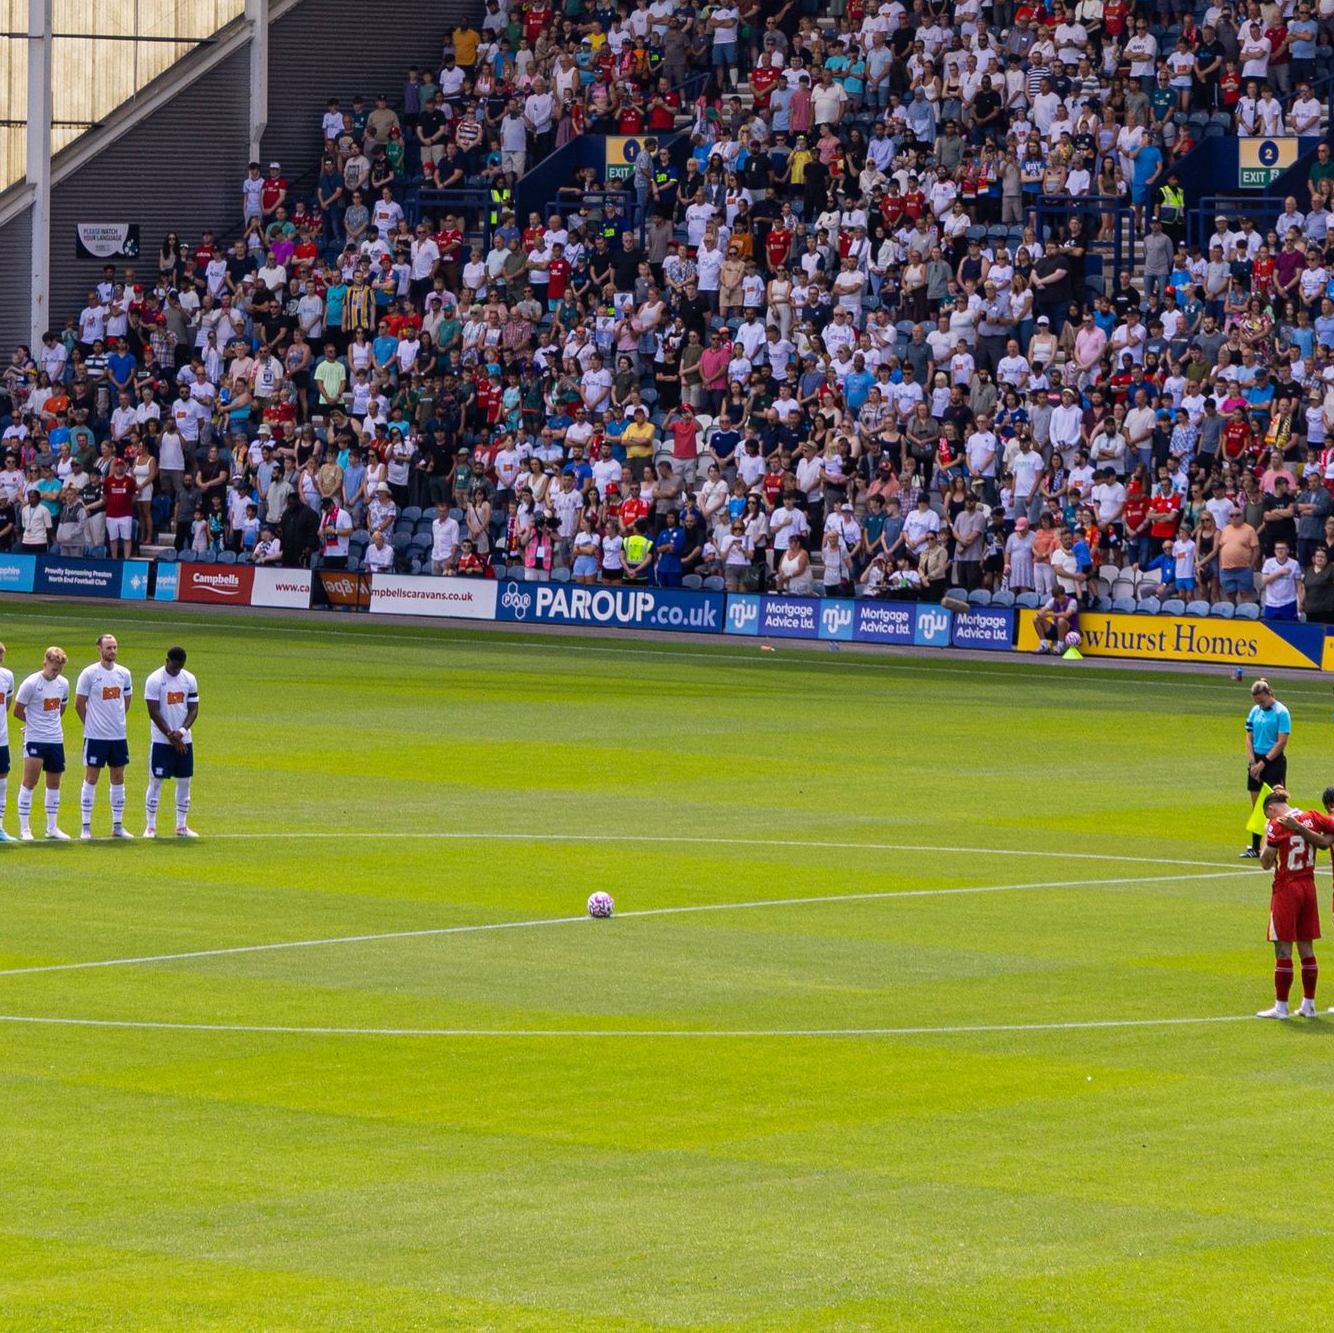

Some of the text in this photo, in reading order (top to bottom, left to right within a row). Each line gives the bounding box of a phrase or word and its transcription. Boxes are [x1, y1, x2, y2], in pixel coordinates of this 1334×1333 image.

[629, 146, 634, 157] 1
[1264, 148, 1273, 159] 2
[609, 167, 629, 178] EXIT
[1243, 171, 1266, 183] EXIT
[193, 573, 240, 586] Campbells
[275, 583, 310, 594] www.ca
[766, 601, 814, 617] Mortgage
[860, 607, 909, 622] Mortgage
[765, 615, 815, 629] Advice Ltd.
[957, 613, 1007, 628] Mortgage
[859, 621, 910, 635] Advice Ltd.
[956, 627, 1008, 640] Advice Ltd.
[1173, 623, 1258, 658] Homes
